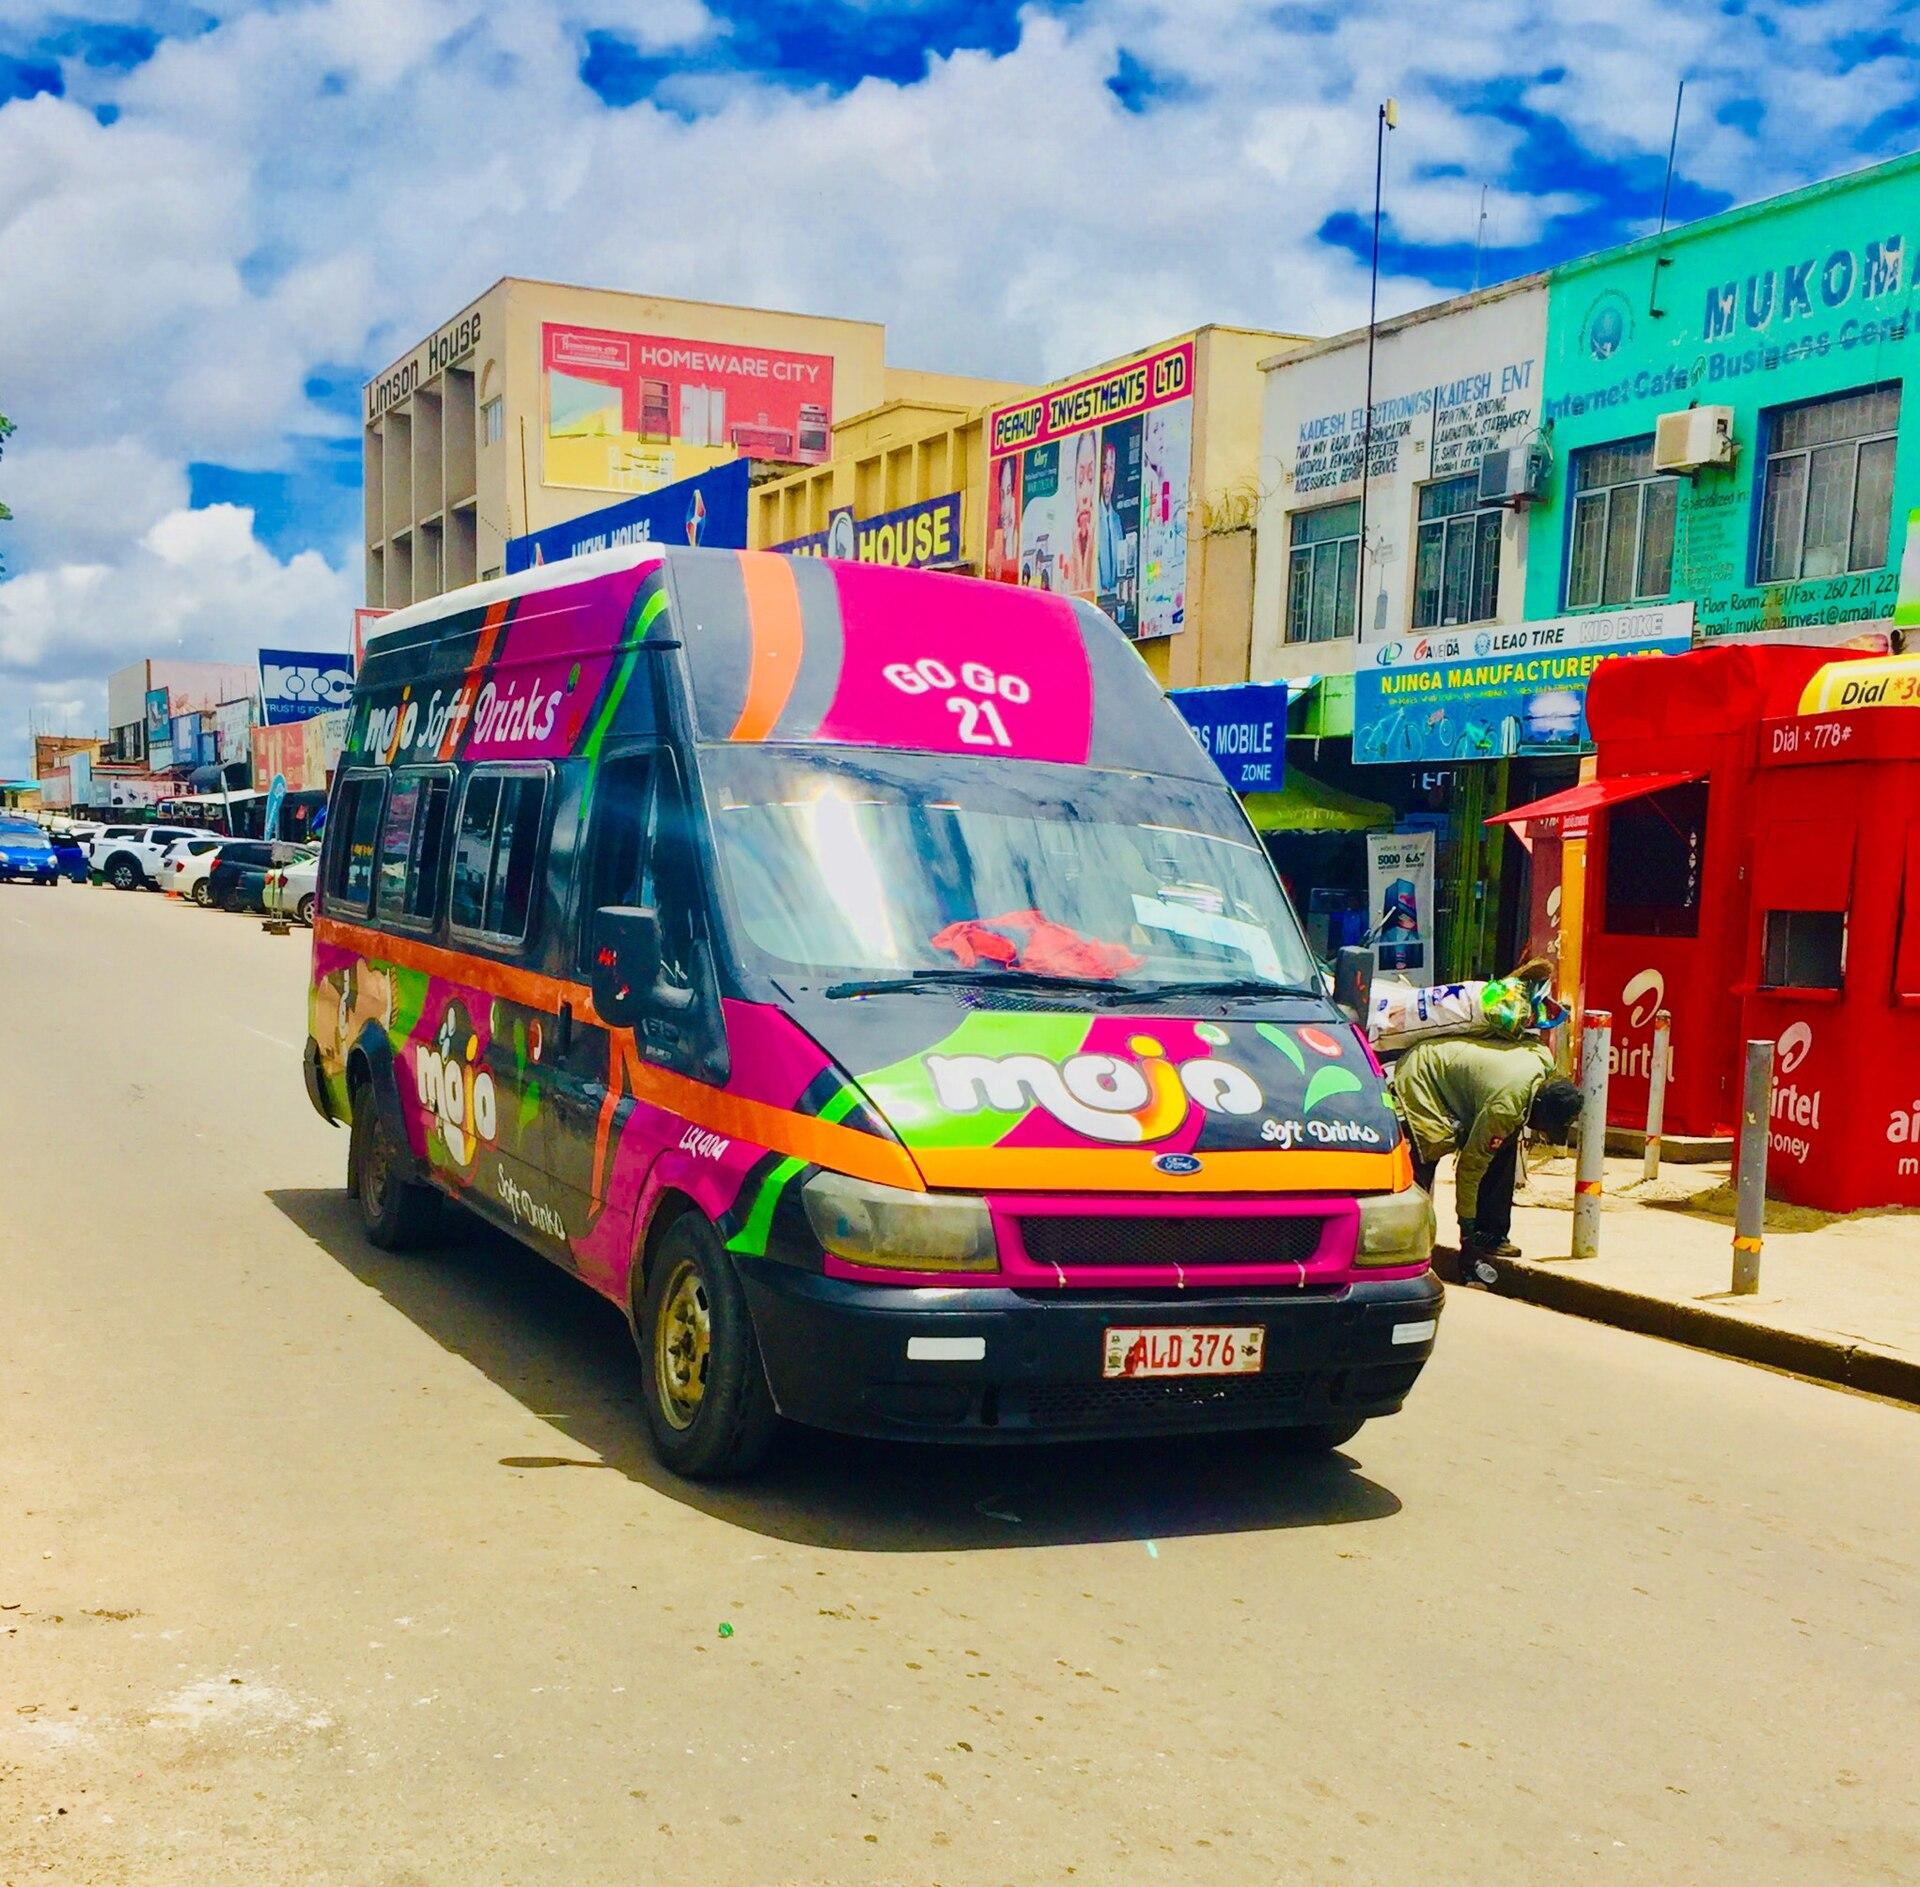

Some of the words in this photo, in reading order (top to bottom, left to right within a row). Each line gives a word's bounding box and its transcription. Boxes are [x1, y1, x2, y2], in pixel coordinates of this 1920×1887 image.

[1703, 234, 1920, 343] MUKOM
[369, 359, 418, 418] Limson
[429, 312, 481, 376] House
[641, 346, 768, 378] HOMEWARE
[772, 360, 819, 384] CITY
[1708, 330, 1831, 382] Business
[996, 405, 1042, 447] PEAKUP
[1049, 369, 1146, 430] INVESTMENTS
[1155, 356, 1184, 394] LTD
[1439, 372, 1492, 410] KADESH
[1502, 360, 1535, 394] ENT
[1299, 412, 1346, 442] KADESH
[859, 505, 950, 567] HOUSE
[1702, 597, 1728, 615] Floor
[1731, 593, 1760, 611] Room
[1824, 580, 1848, 601] 260
[1850, 577, 1871, 596] 211
[1493, 631, 1528, 651] LEAO
[1532, 628, 1565, 646] TIRE
[1580, 619, 1615, 644] KID
[1616, 613, 1664, 639] BIKE
[882, 659, 956, 695] GO
[961, 662, 1030, 704] GO
[1381, 671, 1442, 694] NJINGA
[1841, 678, 1889, 705] Dial
[364, 684, 419, 765] mojo
[417, 688, 472, 758] Soft
[473, 677, 563, 745] Drinks
[945, 696, 1013, 747] 21
[1216, 721, 1273, 755] MOBILE
[1773, 725, 1799, 753] Dial
[1241, 763, 1272, 782] ZONE
[1378, 853, 1400, 865] 5000
[1608, 1036, 1676, 1083] airtl
[416, 1034, 497, 1167] mojo
[924, 1034, 1263, 1142] mojo
[1768, 1075, 1821, 1130] irtel
[1261, 1120, 1302, 1150] Soft
[1307, 1121, 1380, 1143] Drinks
[498, 1162, 522, 1224] Soft
[1134, 1335, 1183, 1369] ALD
[1187, 1334, 1235, 1368] 376
